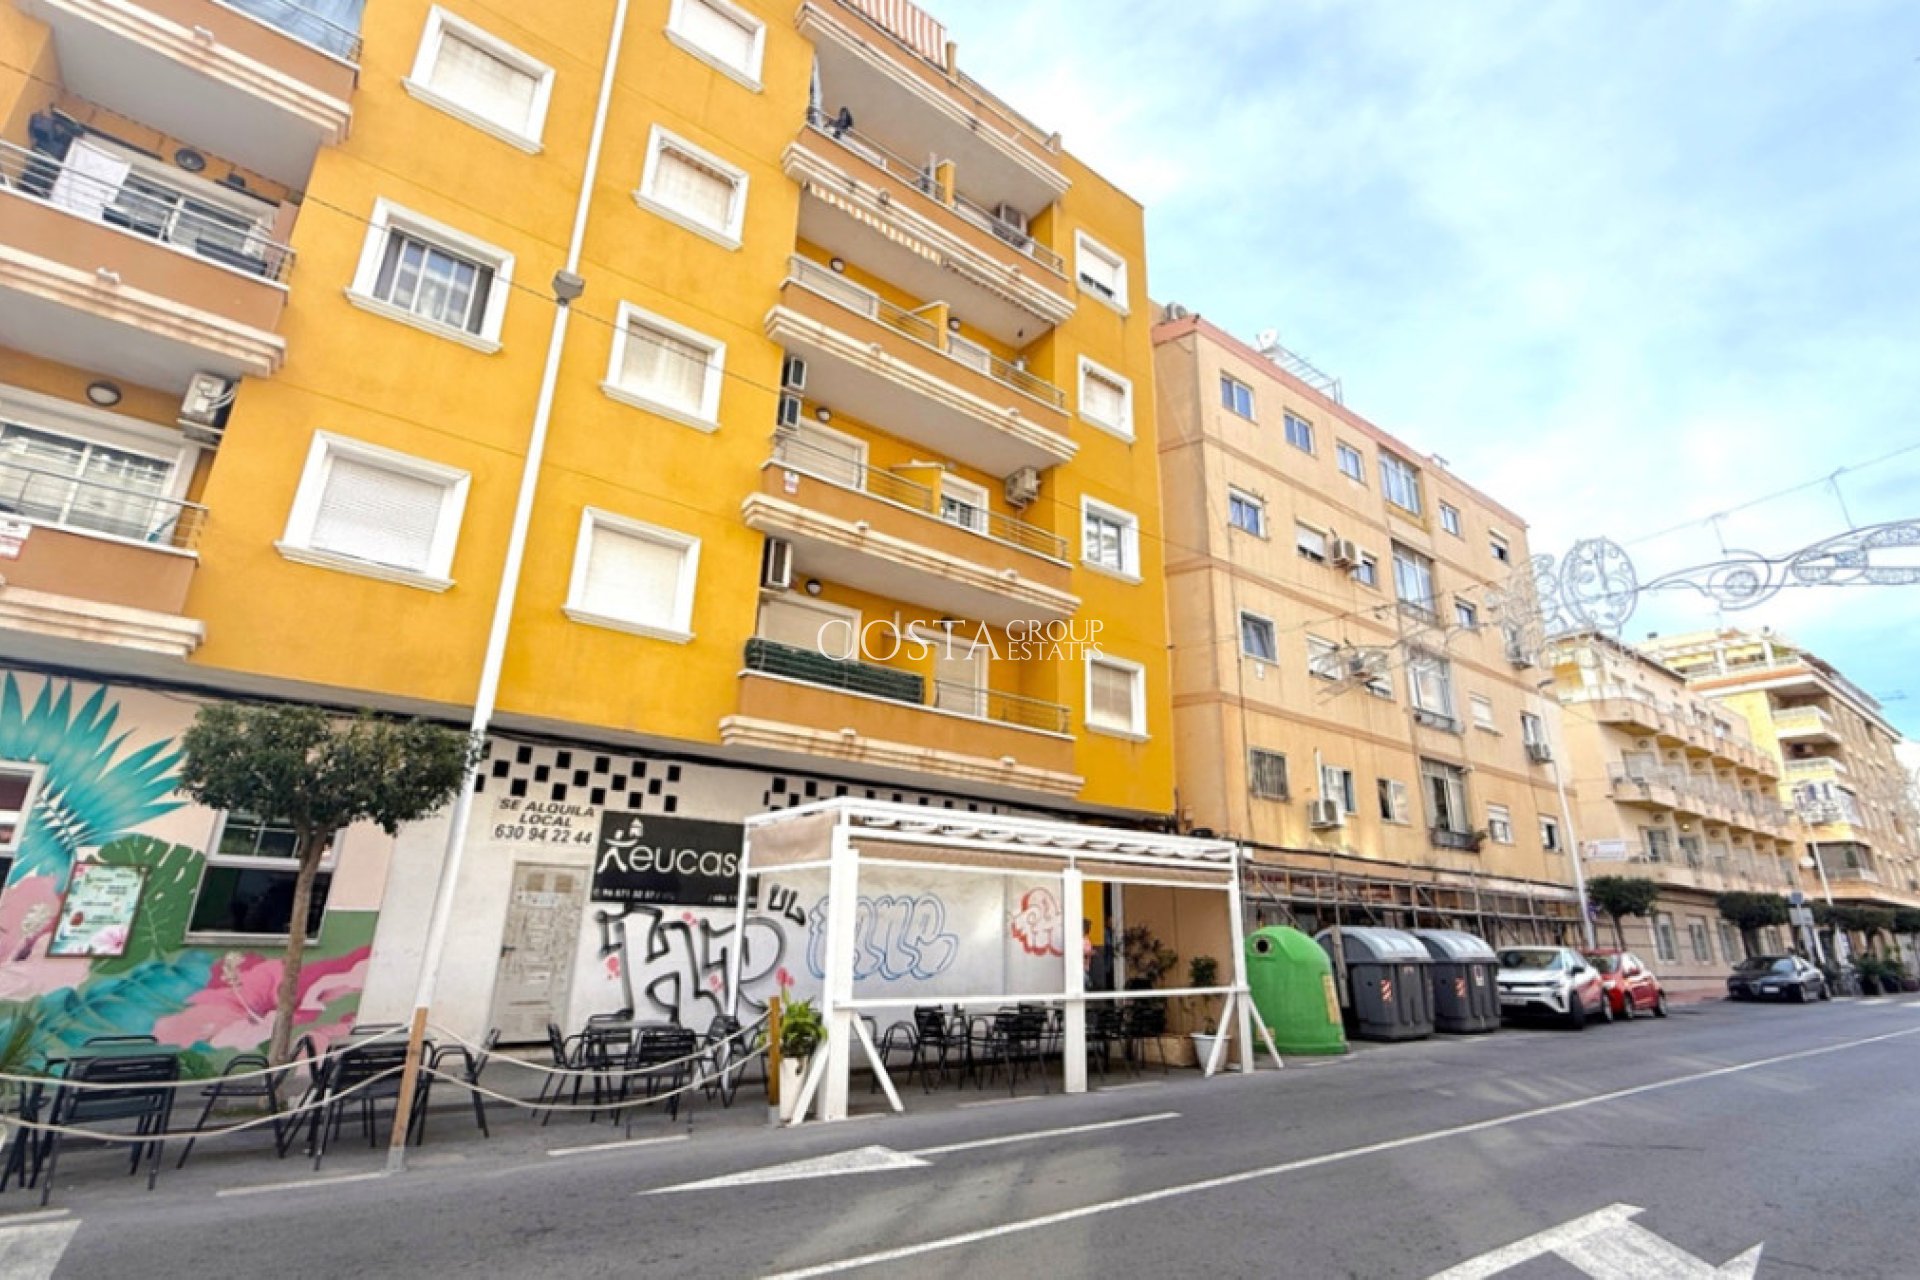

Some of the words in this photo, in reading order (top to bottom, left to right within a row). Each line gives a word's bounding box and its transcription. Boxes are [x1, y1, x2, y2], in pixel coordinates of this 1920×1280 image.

[499, 798, 518, 812] SE
[525, 801, 594, 818] ALQUILA
[519, 813, 571, 828] LOCAL
[494, 824, 525, 840] 630
[528, 827, 547, 841] 94
[551, 828, 570, 844] 22
[573, 830, 593, 844] 44
